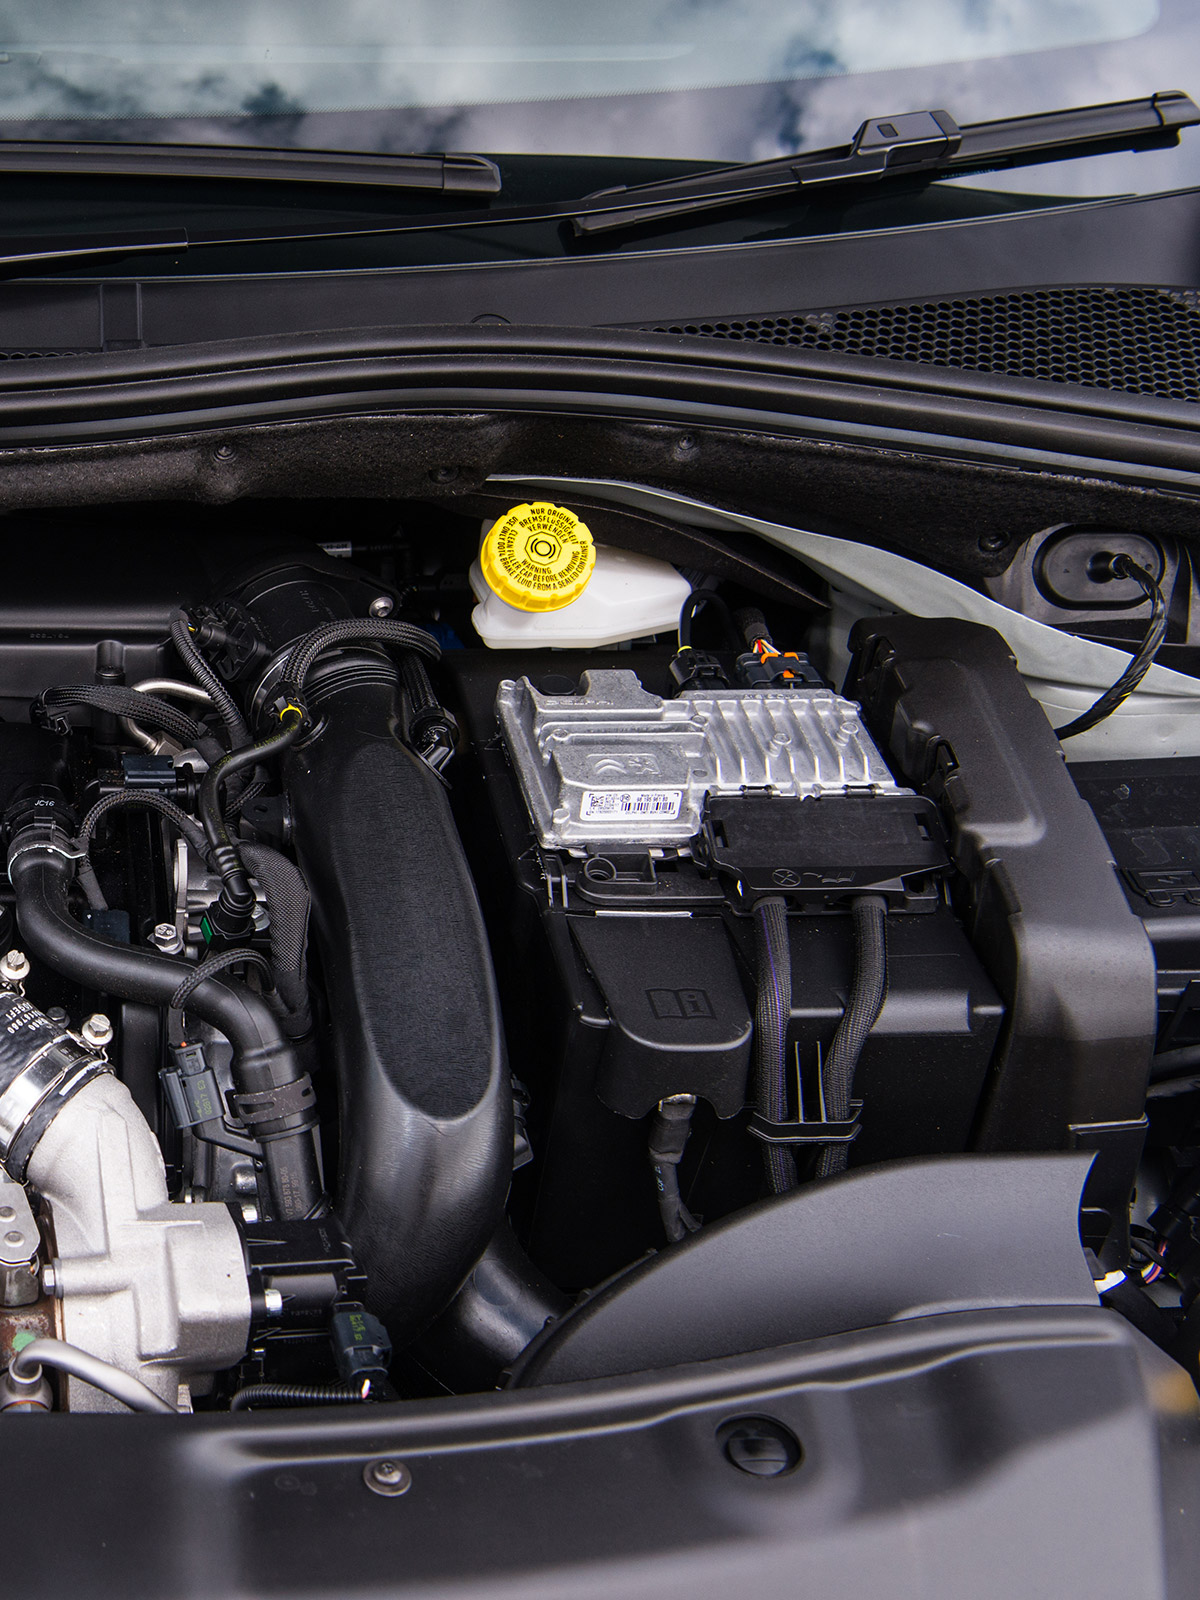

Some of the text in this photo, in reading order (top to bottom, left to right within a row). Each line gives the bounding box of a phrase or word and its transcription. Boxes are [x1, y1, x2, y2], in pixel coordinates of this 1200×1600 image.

[506, 516, 519, 527] USE
[547, 508, 577, 529] ORIGINAL
[498, 526, 510, 541] ONLY
[527, 523, 570, 544] VERWENDEN
[506, 529, 580, 583] CLEAN FILLER CAP BEFORE REMOVING
[577, 540, 589, 574] CONTAINER
[499, 557, 516, 577] BRAKE
[521, 558, 552, 575] WARNING
[513, 575, 532, 588] FLUID
[532, 582, 552, 591] FROM
[552, 582, 558, 590] A
[558, 572, 580, 589] SEALED
[34, 799, 56, 807] JC16
